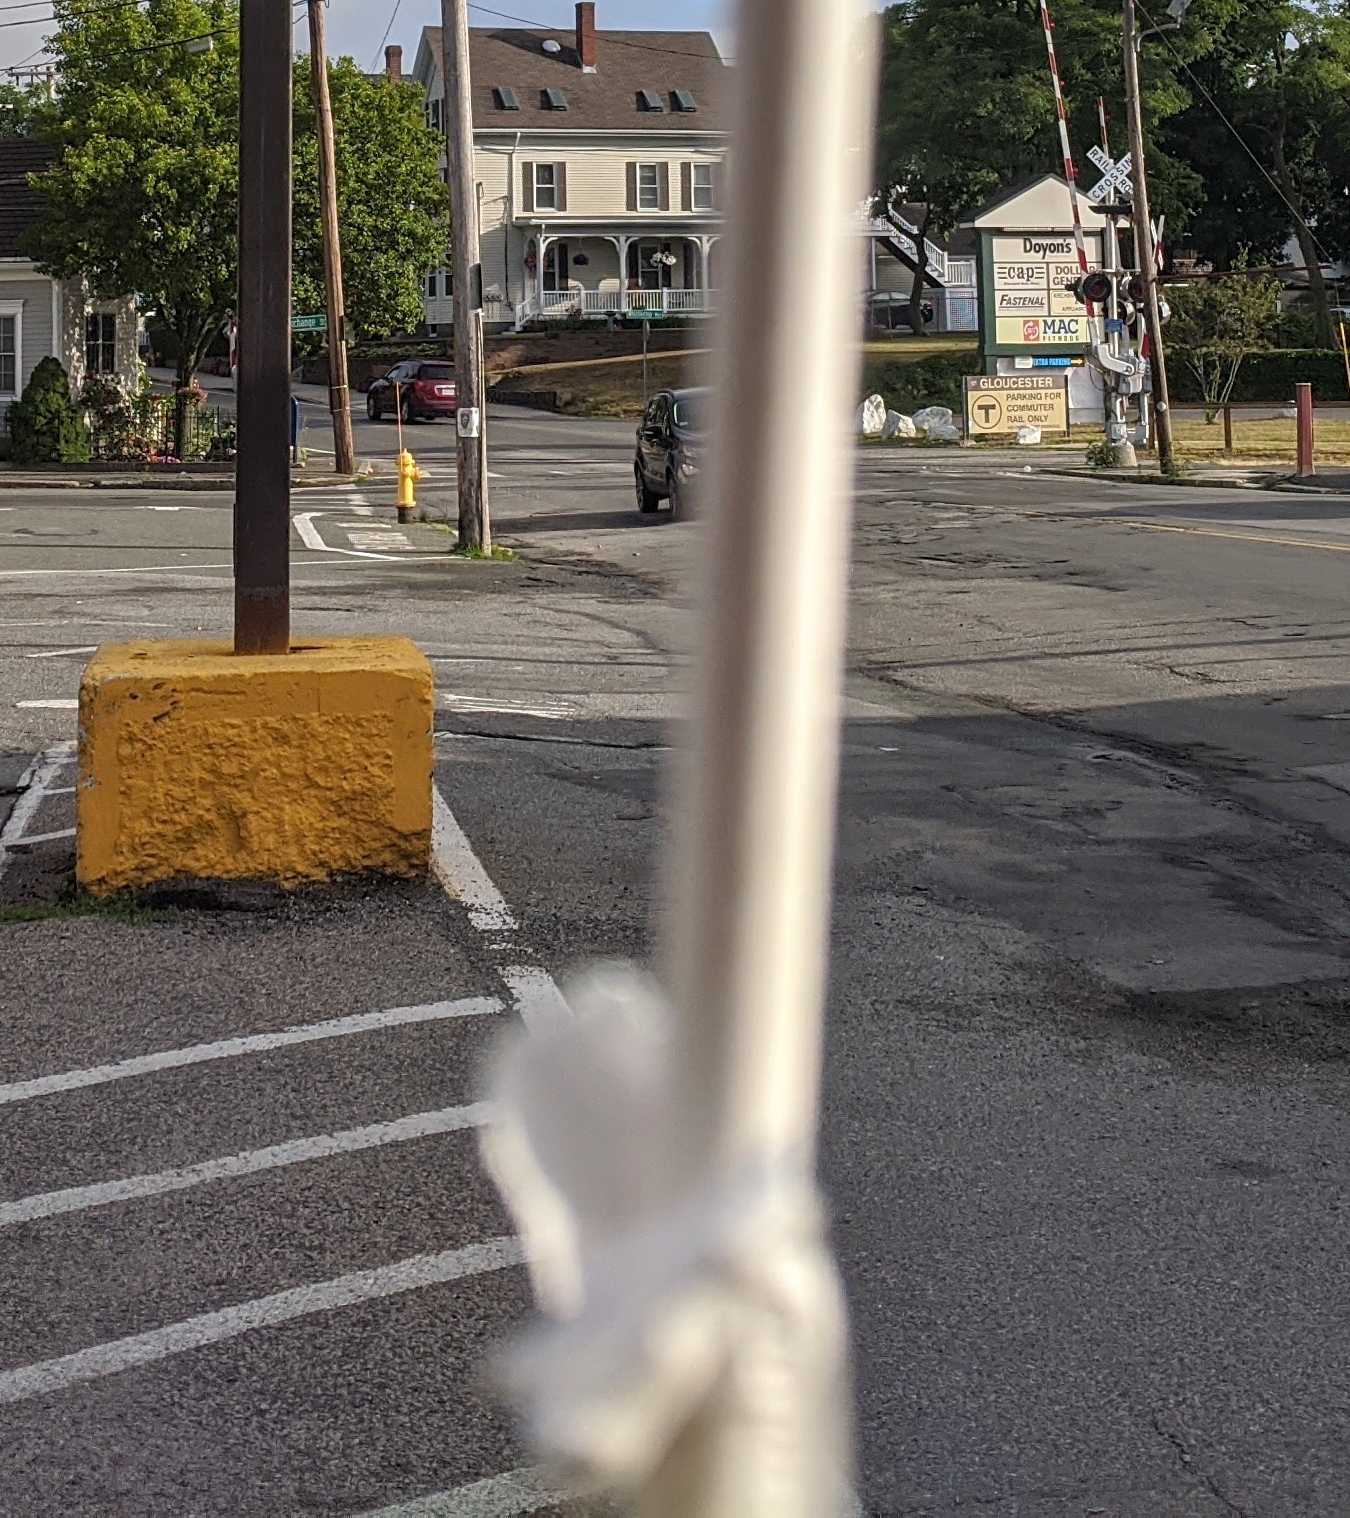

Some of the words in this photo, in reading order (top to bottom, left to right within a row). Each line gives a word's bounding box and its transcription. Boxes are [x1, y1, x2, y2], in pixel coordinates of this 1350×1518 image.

[1089, 148, 1110, 172] RAIL
[1092, 157, 1132, 199] CROSSIN
[1023, 237, 1072, 260] Doyon's
[1042, 319, 1079, 335] MAC
[979, 377, 1053, 389] GLOUCESTER
[1006, 393, 1043, 401] PARKING
[1044, 392, 1062, 400] FOR
[977, 403, 997, 424] T
[1006, 403, 1055, 413] COMMUTER
[1006, 415, 1025, 424] RAIL
[1027, 414, 1049, 423] ONLY
